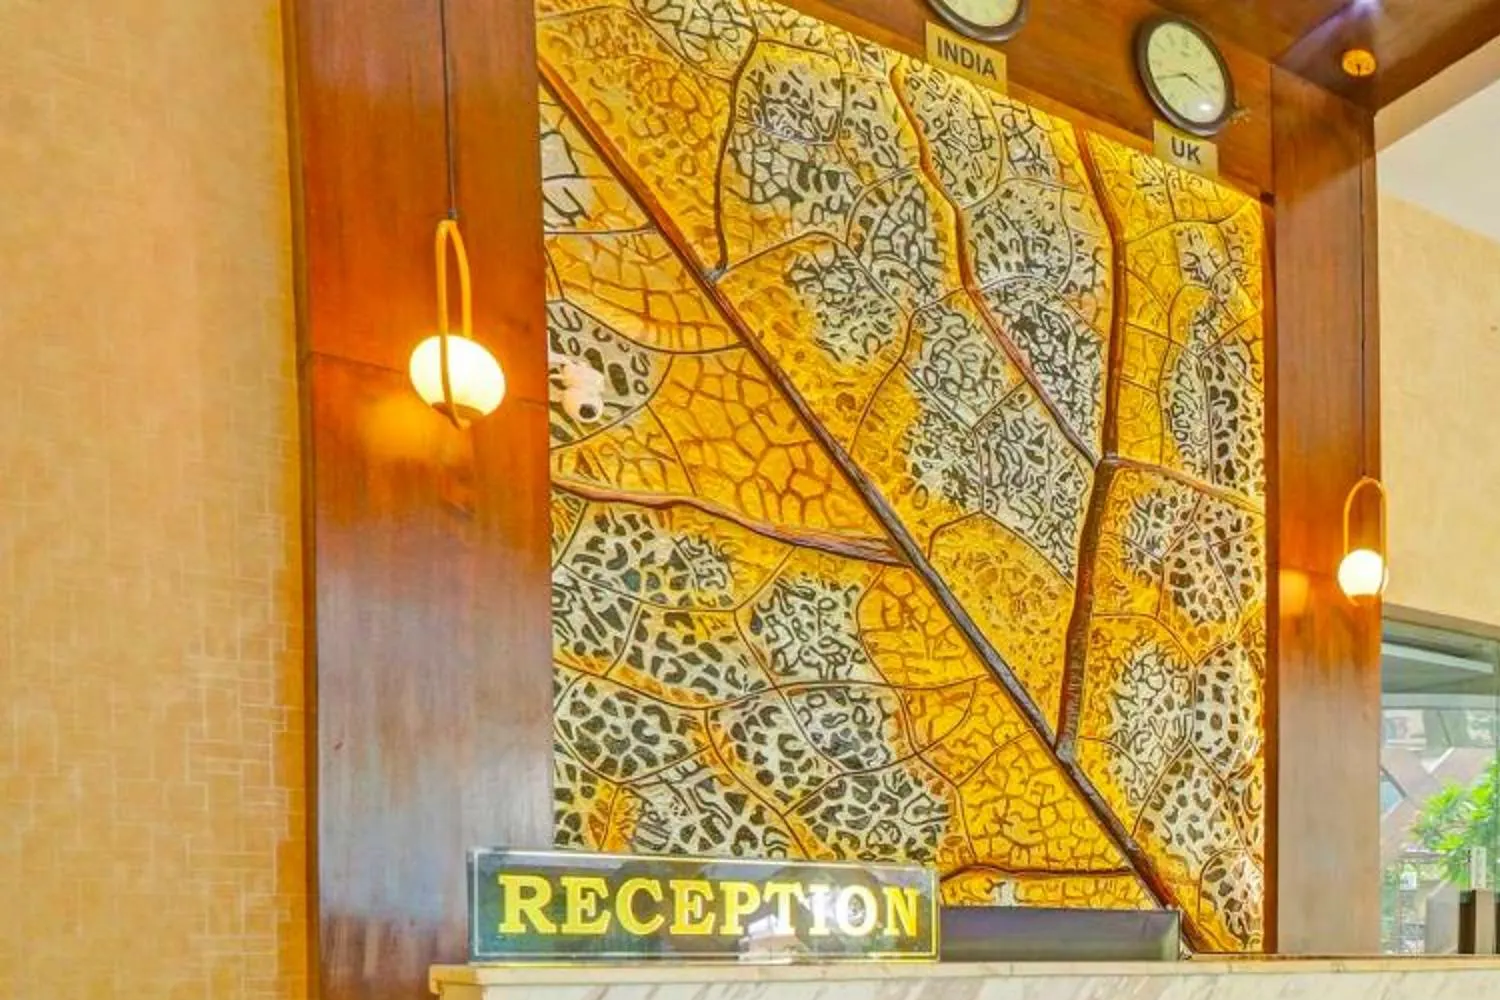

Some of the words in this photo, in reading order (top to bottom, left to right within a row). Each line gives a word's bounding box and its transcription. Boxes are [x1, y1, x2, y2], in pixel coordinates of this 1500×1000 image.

[936, 36, 998, 80] INDIA
[1169, 135, 1202, 165] UK
[497, 873, 921, 938] RECEPTION
